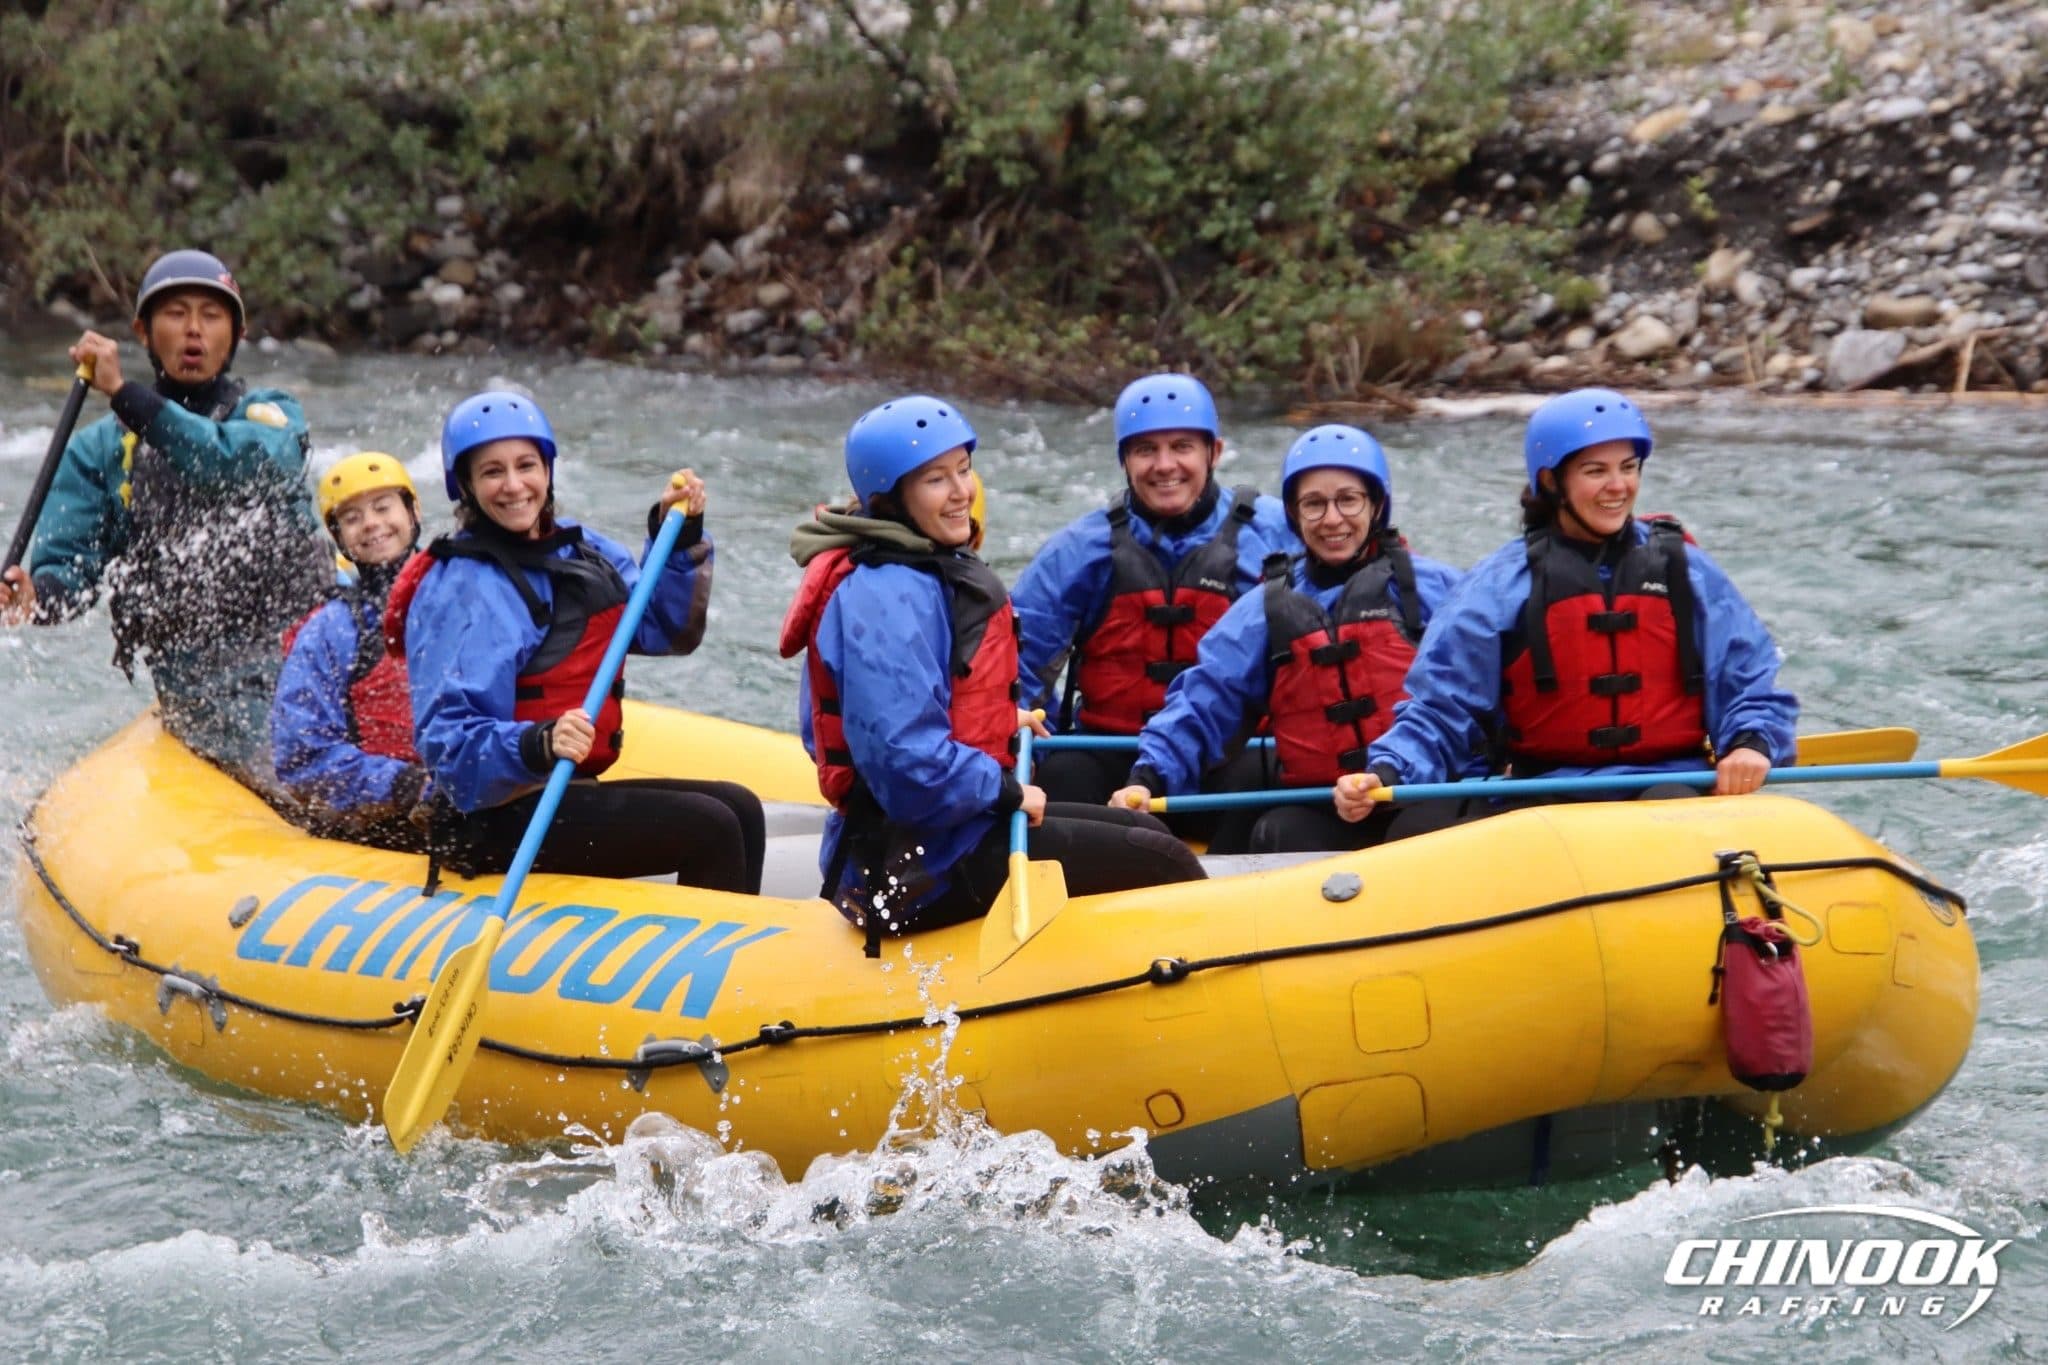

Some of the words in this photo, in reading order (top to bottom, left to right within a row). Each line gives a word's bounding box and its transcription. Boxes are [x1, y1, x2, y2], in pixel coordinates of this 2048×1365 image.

[1360, 608, 1388, 620] NRS
[236, 874, 790, 1020] CHINOOK
[447, 1000, 477, 1065] CHINOOK
